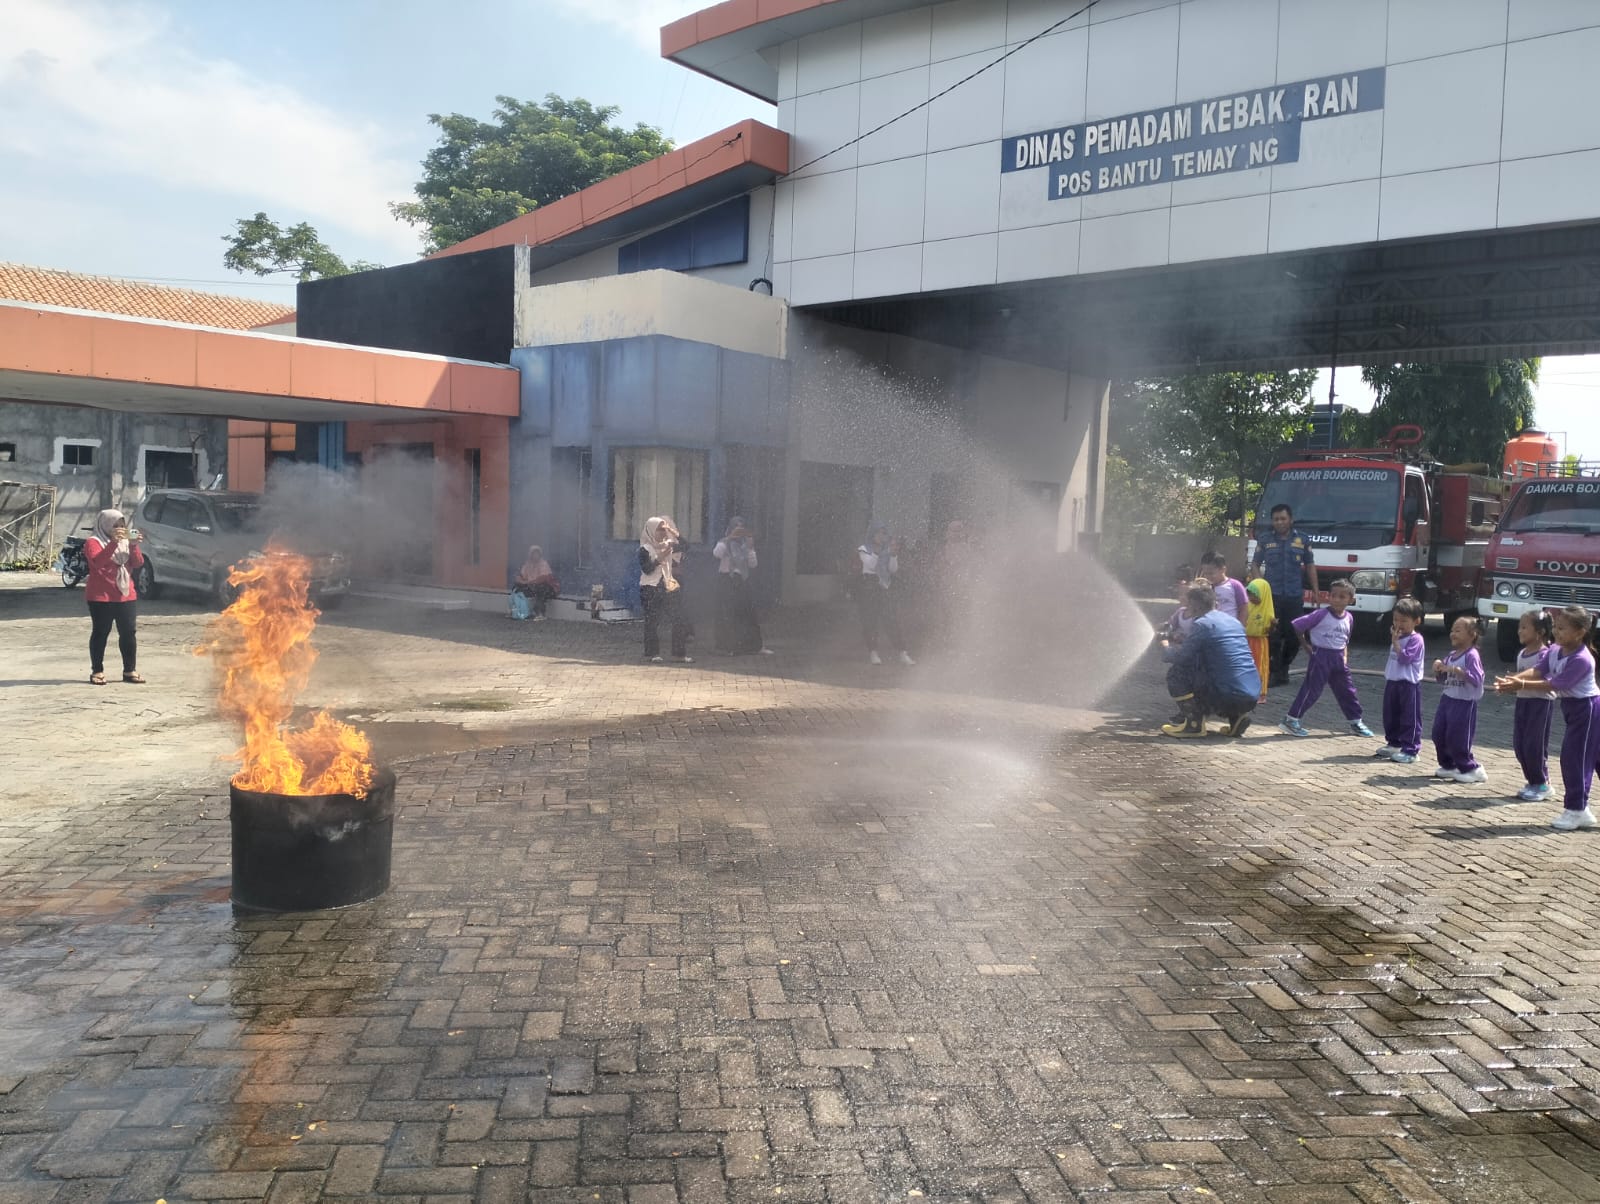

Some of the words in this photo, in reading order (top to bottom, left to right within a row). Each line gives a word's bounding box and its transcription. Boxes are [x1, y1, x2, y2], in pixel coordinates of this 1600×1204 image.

[1015, 129, 1077, 168] DINAS
[1084, 107, 1192, 157] PEMADAM
[1058, 170, 1092, 196] POS
[1098, 157, 1162, 189] BANTU
[1281, 471, 1321, 480] DAMKAR
[1322, 470, 1388, 481] BOJONEGORO
[1526, 484, 1574, 494] DAMKAR
